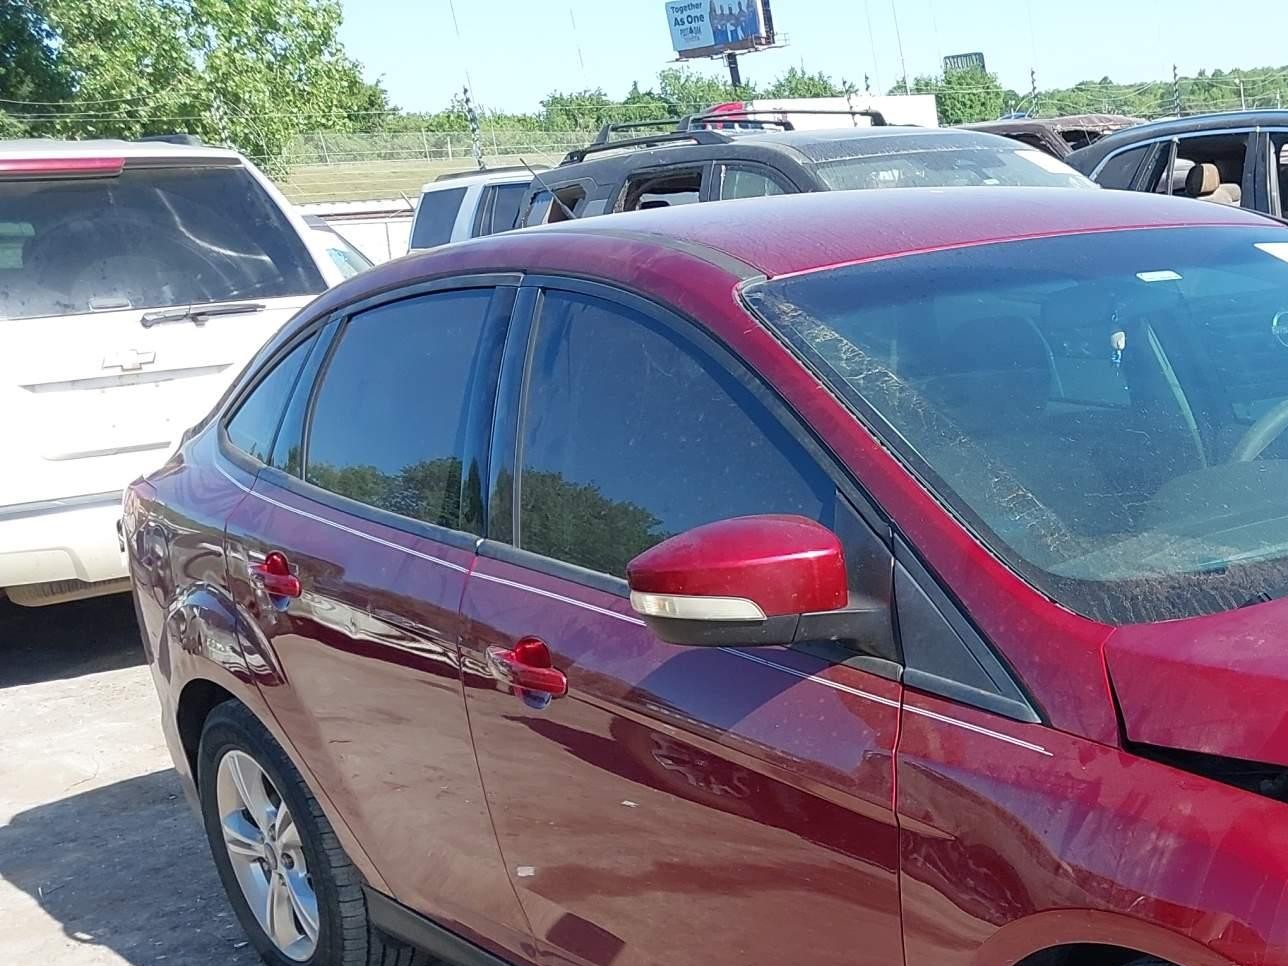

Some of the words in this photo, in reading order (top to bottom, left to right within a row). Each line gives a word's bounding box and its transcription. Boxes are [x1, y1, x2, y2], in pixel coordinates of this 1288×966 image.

[670, 2, 702, 14] Together
[673, 17, 686, 27] As
[686, 14, 705, 24] One
